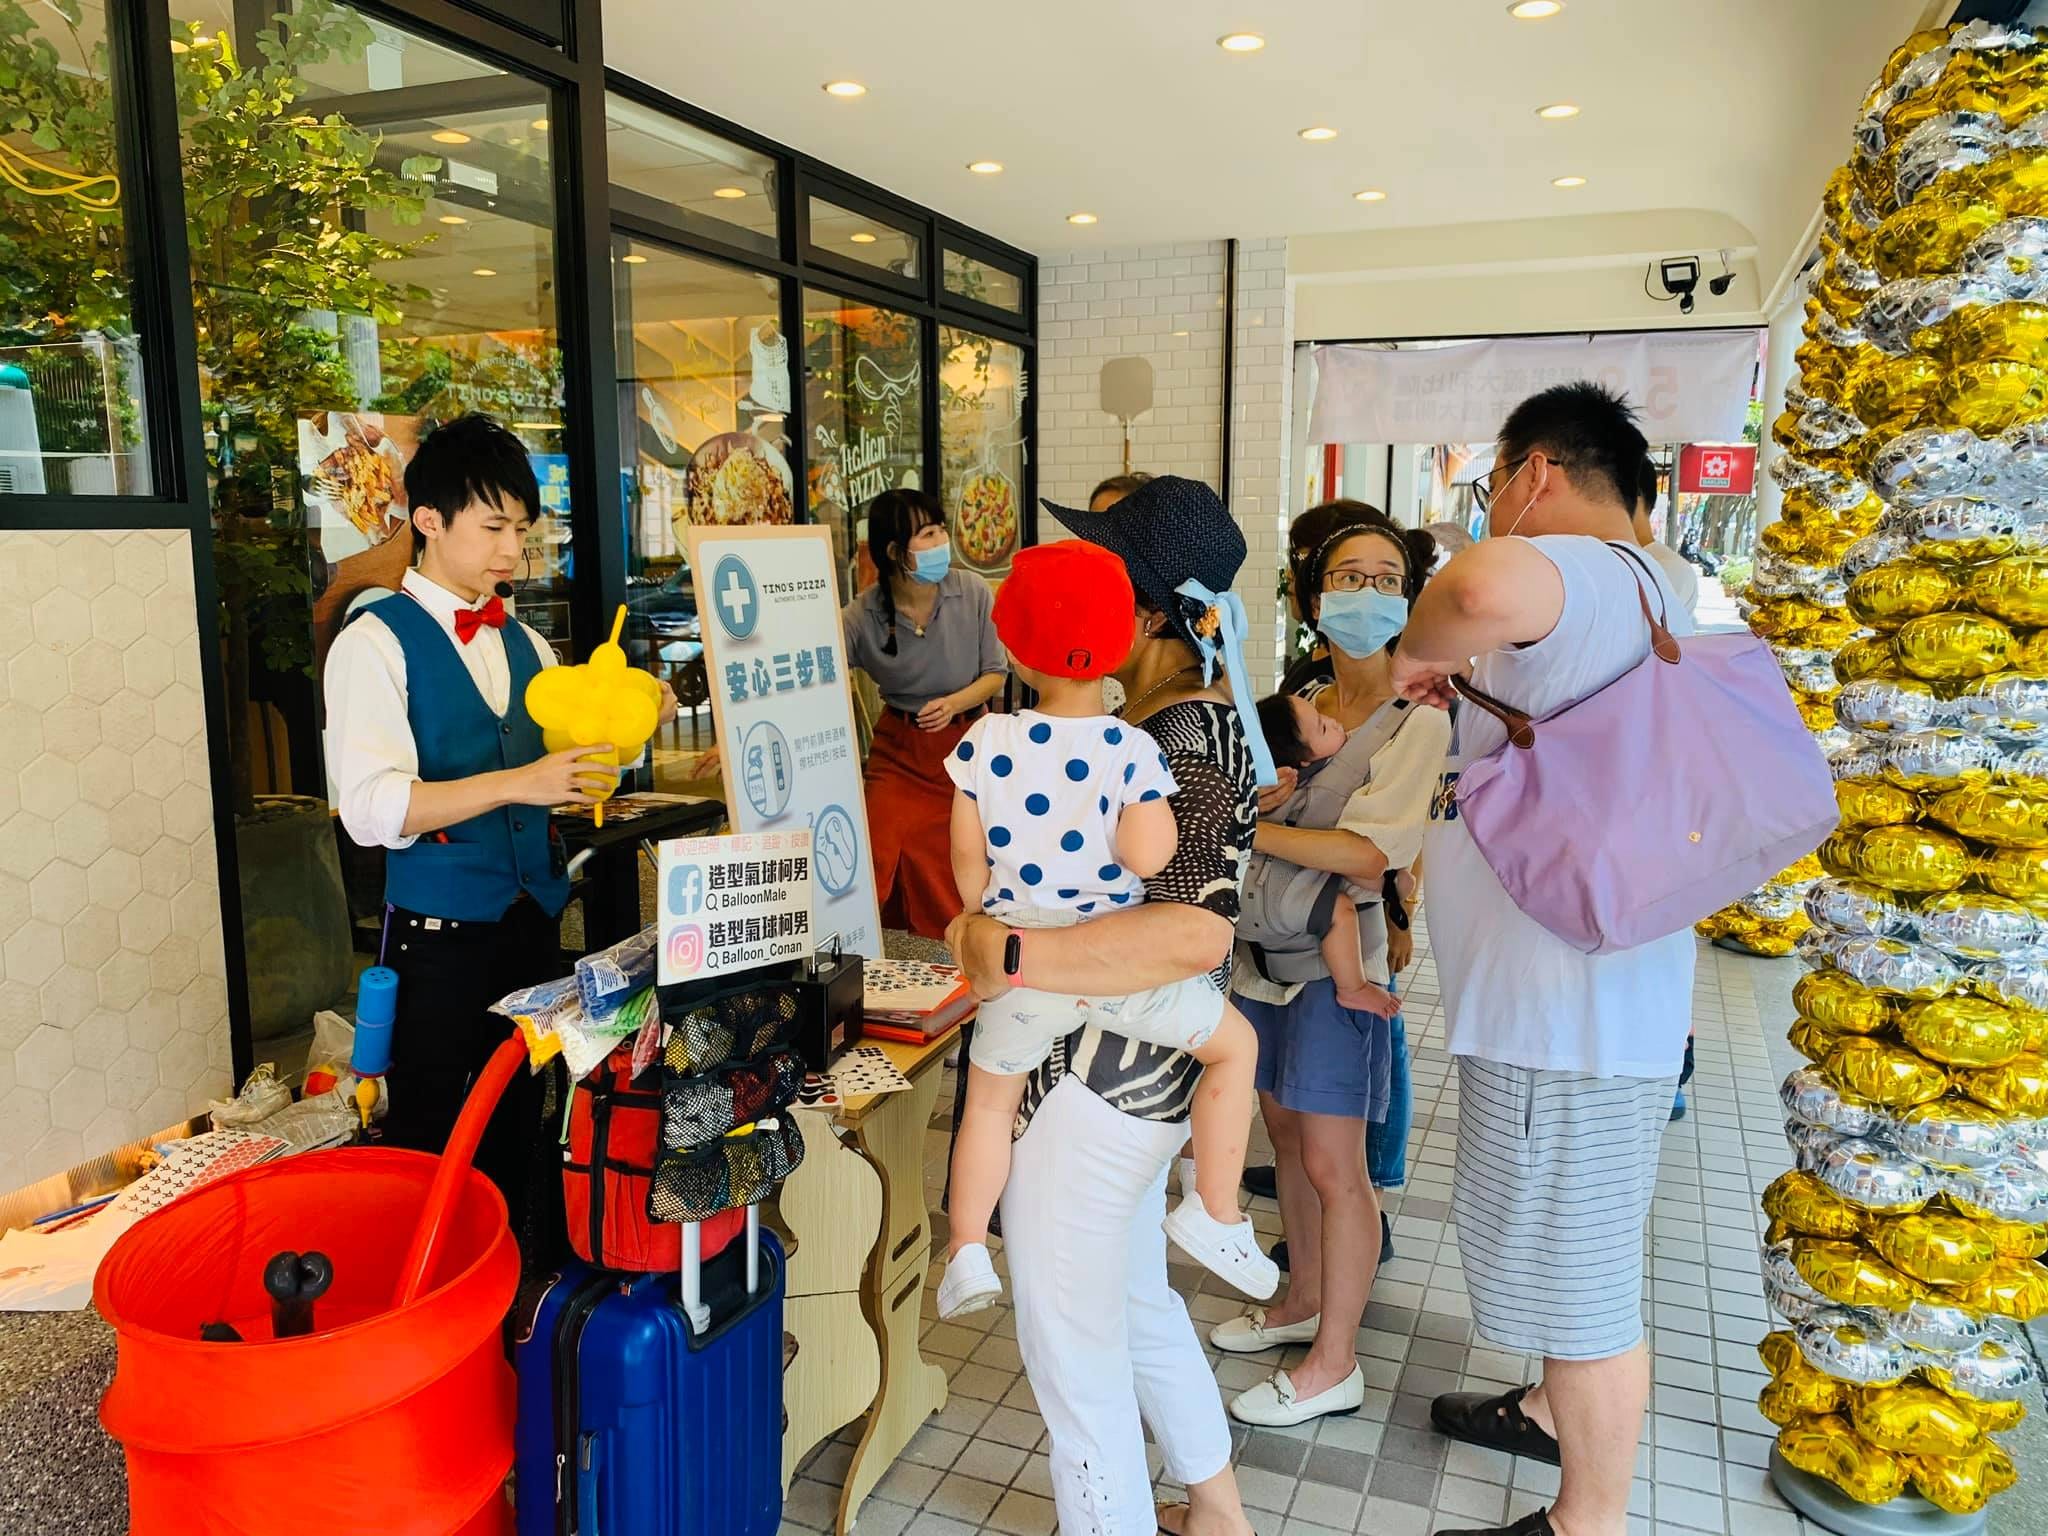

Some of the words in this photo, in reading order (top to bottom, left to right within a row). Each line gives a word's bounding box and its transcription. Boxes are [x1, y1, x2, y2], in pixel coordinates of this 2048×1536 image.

[849, 466, 887, 508] PIZZA
[797, 578, 827, 591] PIZZA
[725, 646, 836, 702] 安心三步驟
[708, 856, 808, 891] 造型氣球柯男
[722, 888, 787, 908] BalloonMale
[708, 910, 809, 949] 造型氣球柯男
[722, 941, 803, 966] Balloon_Conan
